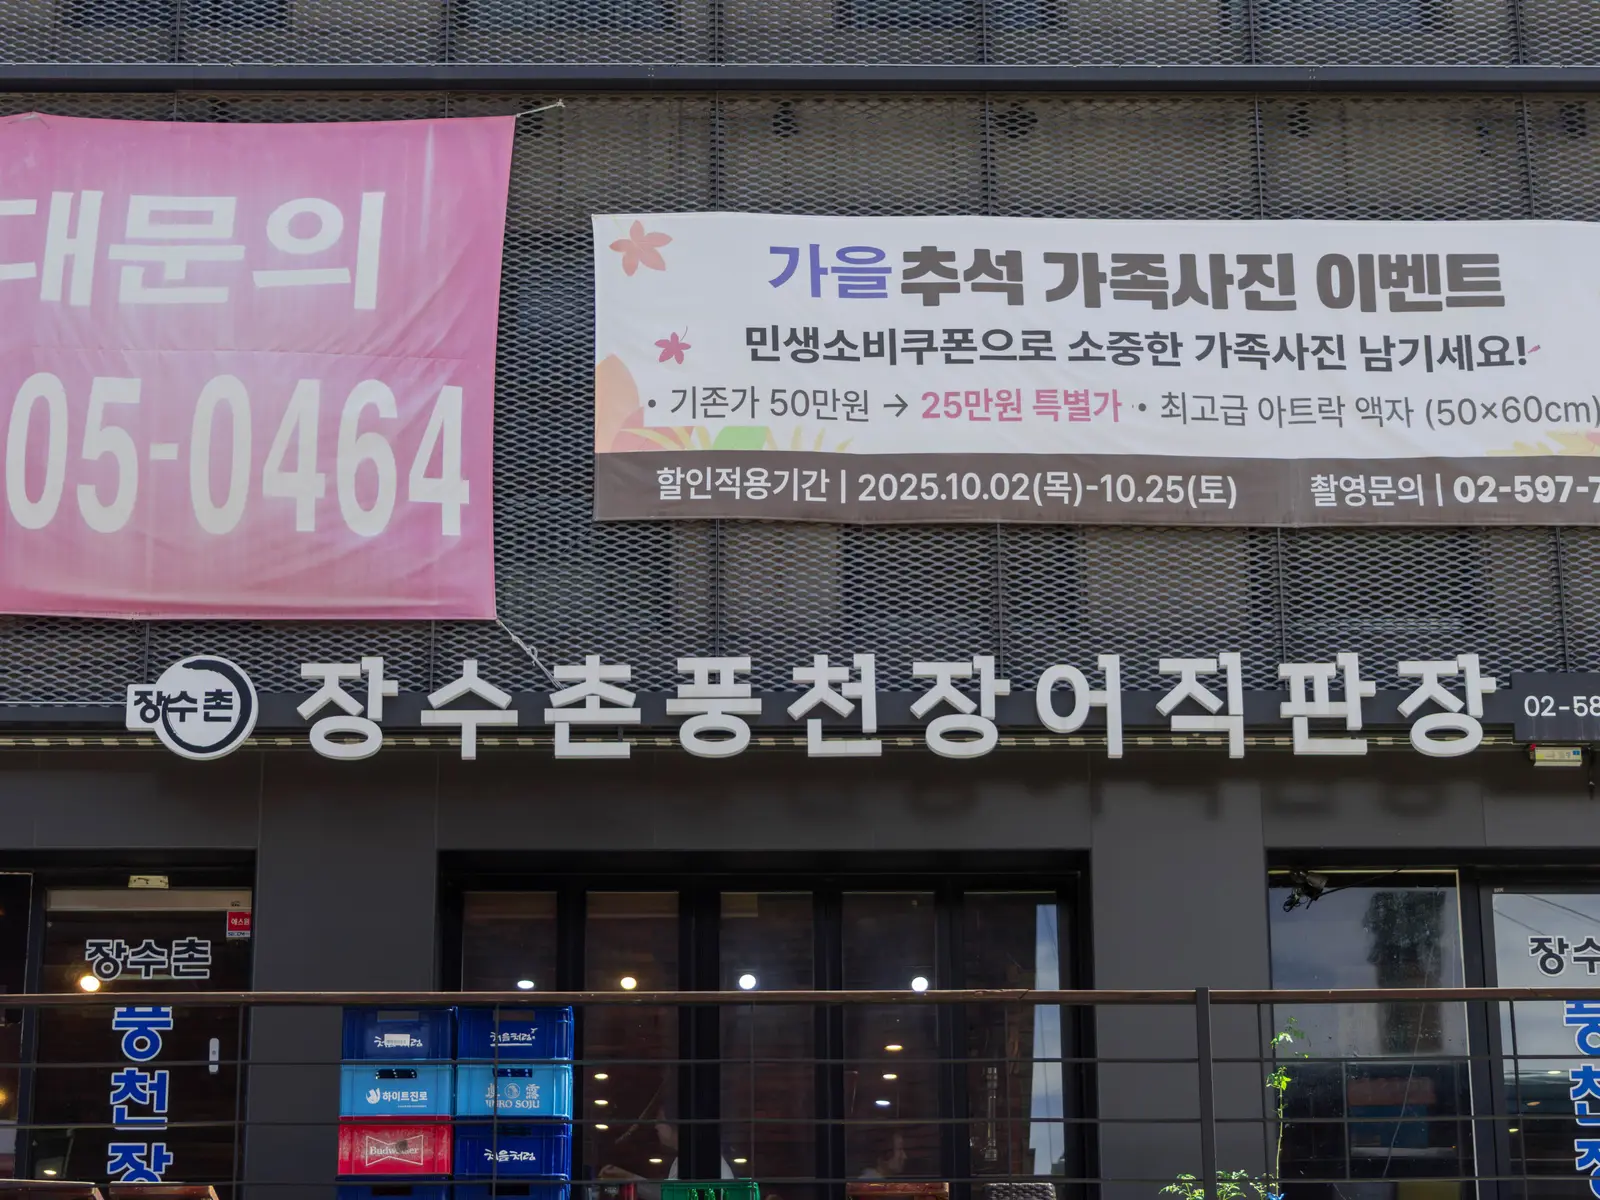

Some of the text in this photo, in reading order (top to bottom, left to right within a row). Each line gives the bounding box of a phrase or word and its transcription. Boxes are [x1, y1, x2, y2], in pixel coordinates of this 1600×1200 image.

[0, 190, 386, 310] 대문의
[1043, 252, 1297, 311] 가족사진
[1316, 252, 1506, 313] 이벤트
[745, 324, 1528, 373] 민생소비쿠폰으로 소중한 가족사진 남기세요!
[670, 385, 760, 419] 기존가
[770, 388, 870, 422] 50만원
[921, 387, 1023, 423] 25만원
[1032, 388, 1123, 423] 특별가
[1161, 391, 1249, 427] 최고급
[1258, 396, 1346, 429] 아트락
[1355, 397, 1415, 429] 액자
[5, 373, 470, 537] 05-0464
[656, 466, 1238, 510] 할인적용기간 2025.10.02(목)-10.25(토)
[1310, 473, 1600, 507] 촬영문의 02-597-7
[134, 689, 233, 723] 장수촌
[297, 652, 1496, 761] 장수촌풍천장어직판장
[1524, 695, 1600, 717] 02-58
[85, 937, 212, 981] 장수촌
[382, 1091, 428, 1102] 하이트진로
[515, 1100, 540, 1109] SOJU
[370, 1146, 419, 1155] Budwer
